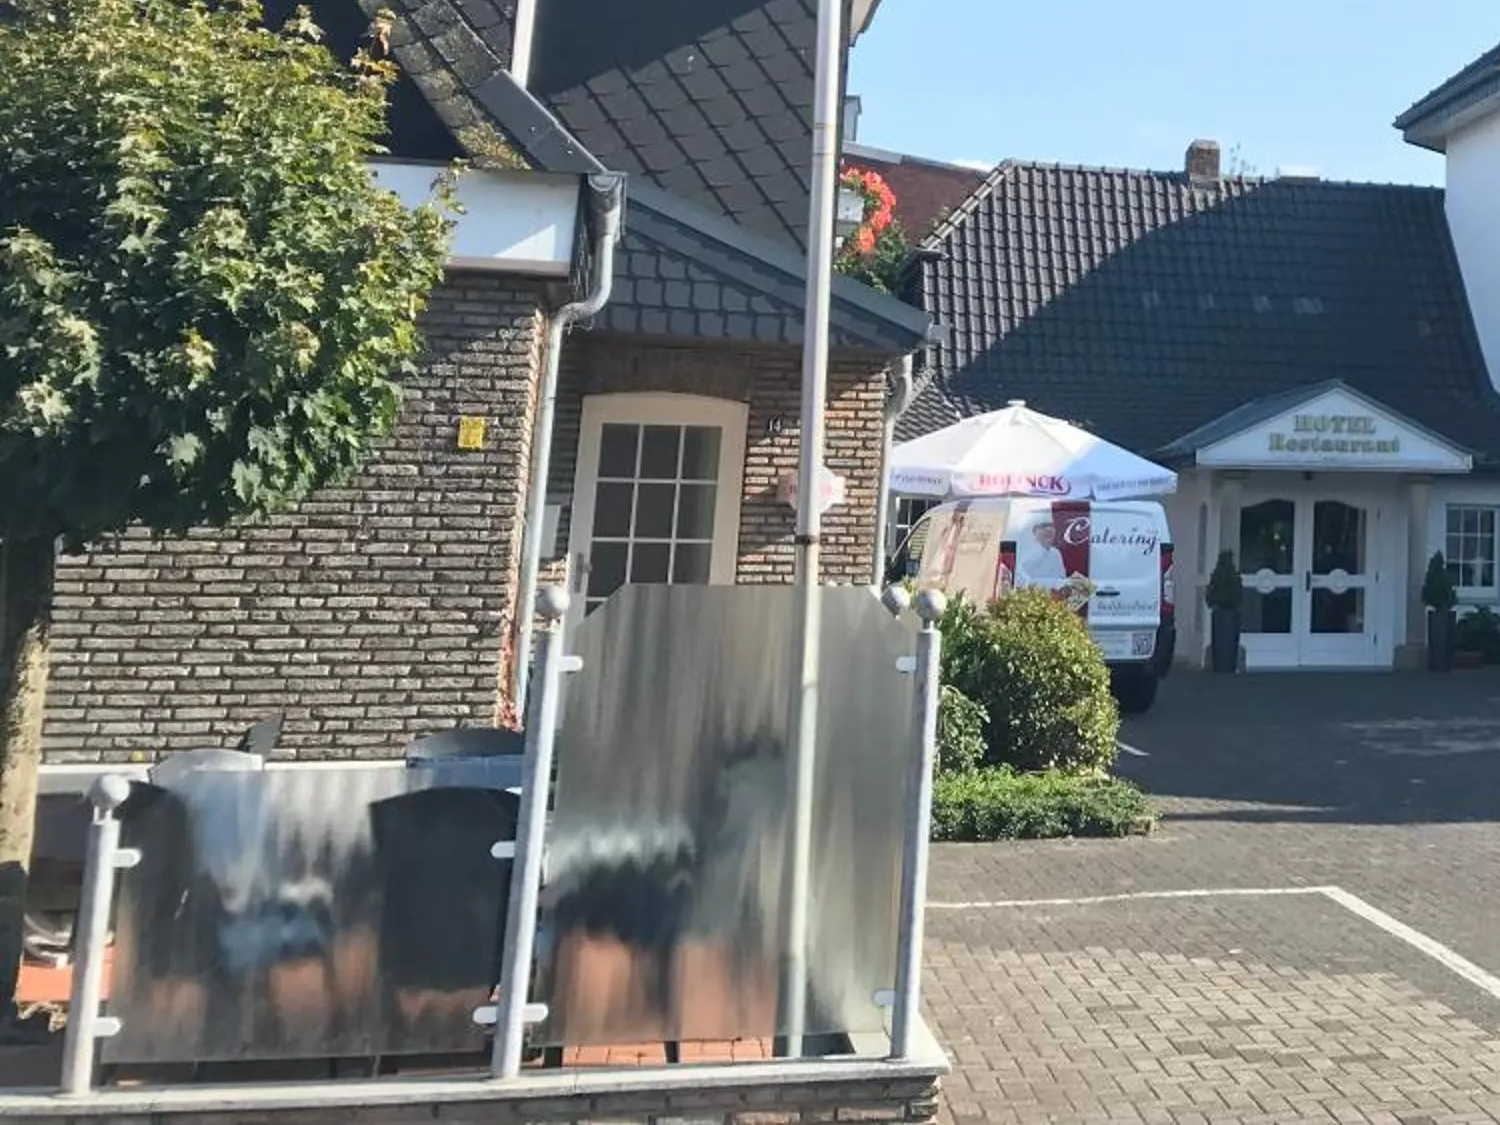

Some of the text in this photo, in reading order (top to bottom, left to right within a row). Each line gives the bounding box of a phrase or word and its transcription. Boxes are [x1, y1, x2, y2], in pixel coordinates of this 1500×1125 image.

[768, 419, 782, 432] 14
[1293, 415, 1376, 433] HOTEL
[1268, 433, 1399, 453] Restaurant
[1063, 516, 1158, 555] Catering
